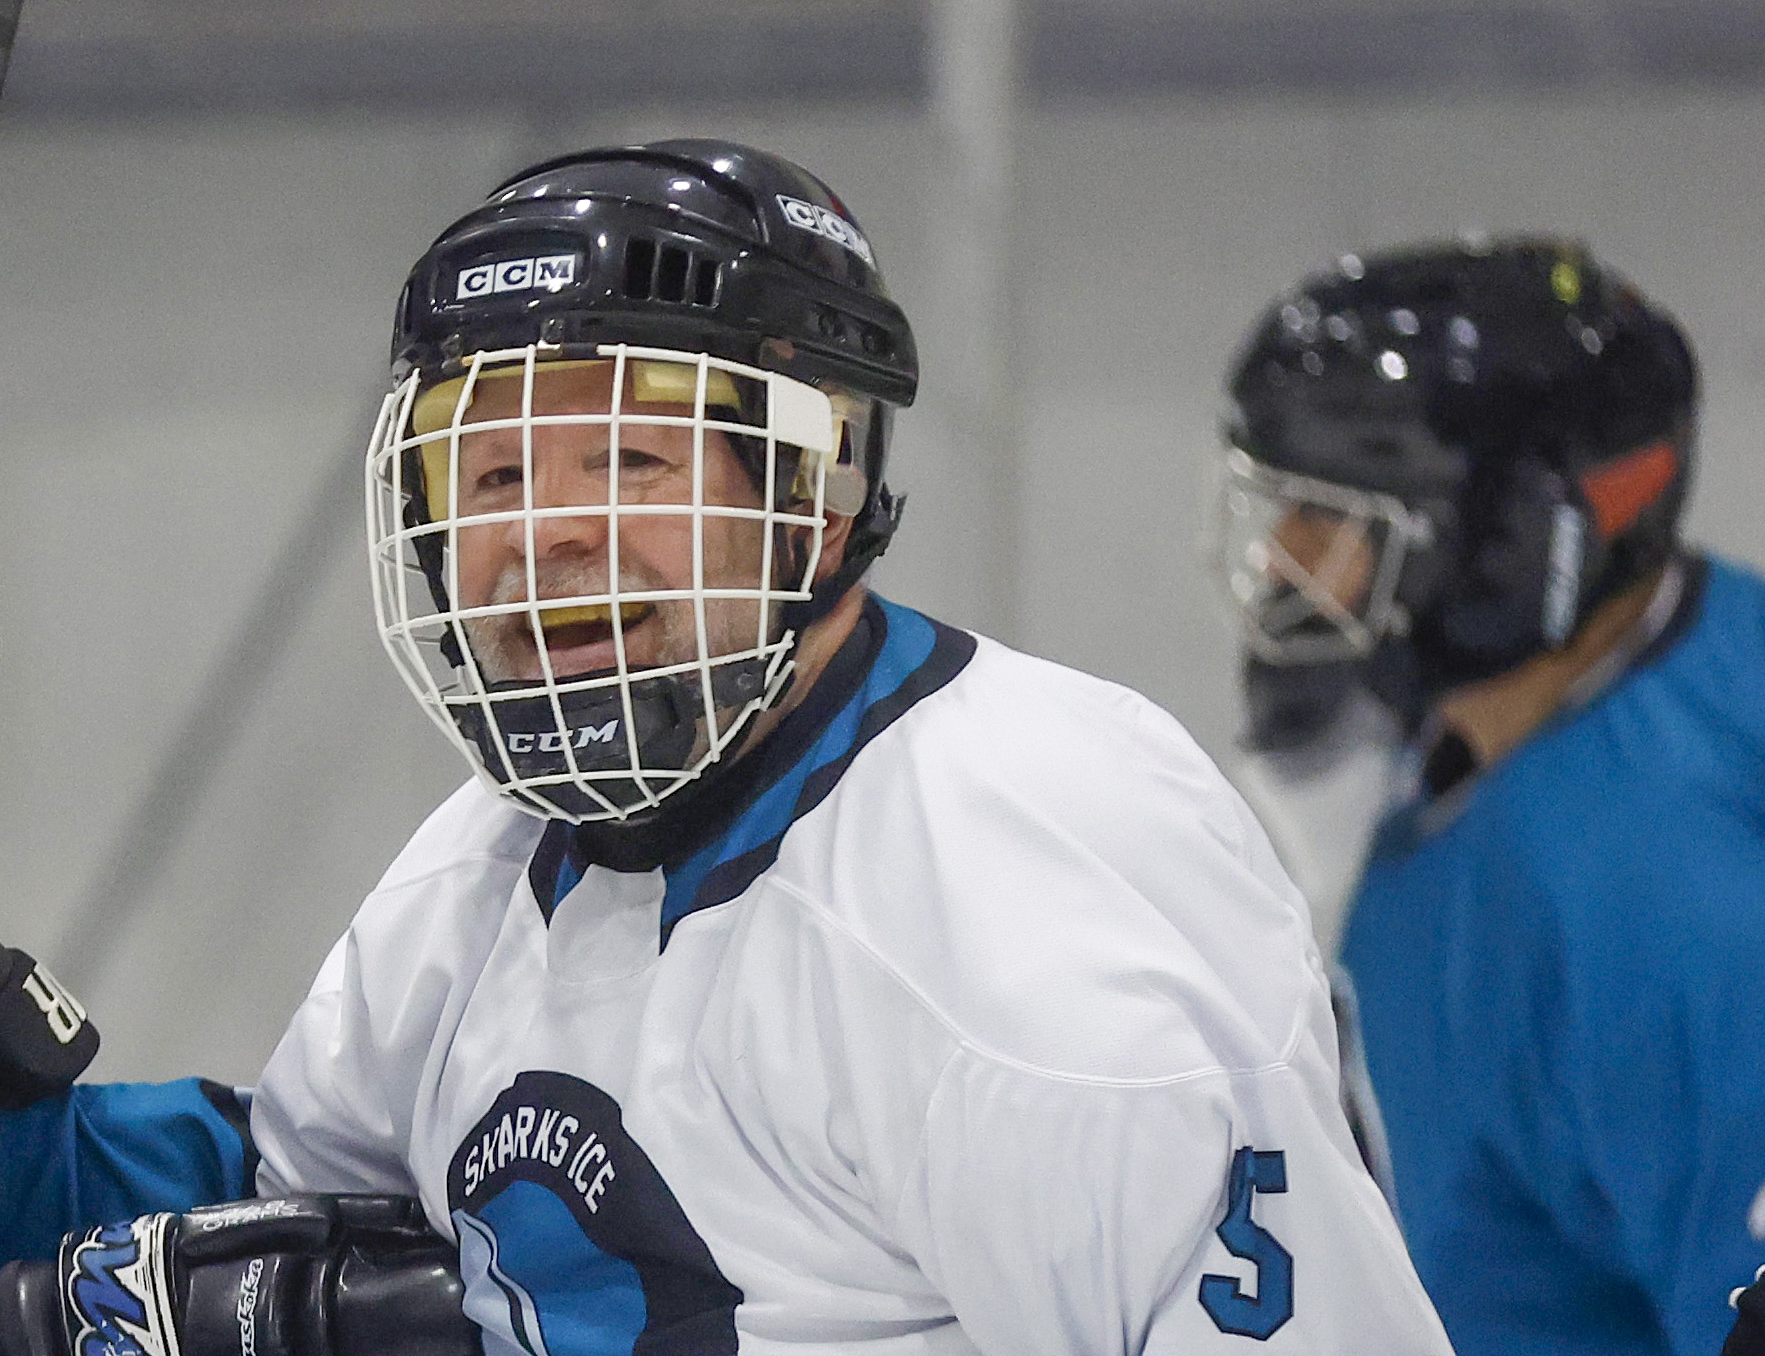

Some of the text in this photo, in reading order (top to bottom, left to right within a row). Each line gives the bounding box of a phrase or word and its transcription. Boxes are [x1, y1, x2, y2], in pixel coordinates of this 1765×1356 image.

[460, 257, 574, 296] CCM
[507, 719, 620, 753] CCM
[464, 1106, 616, 1214] SHARKS ICE
[1198, 1145, 1295, 1341] 5
